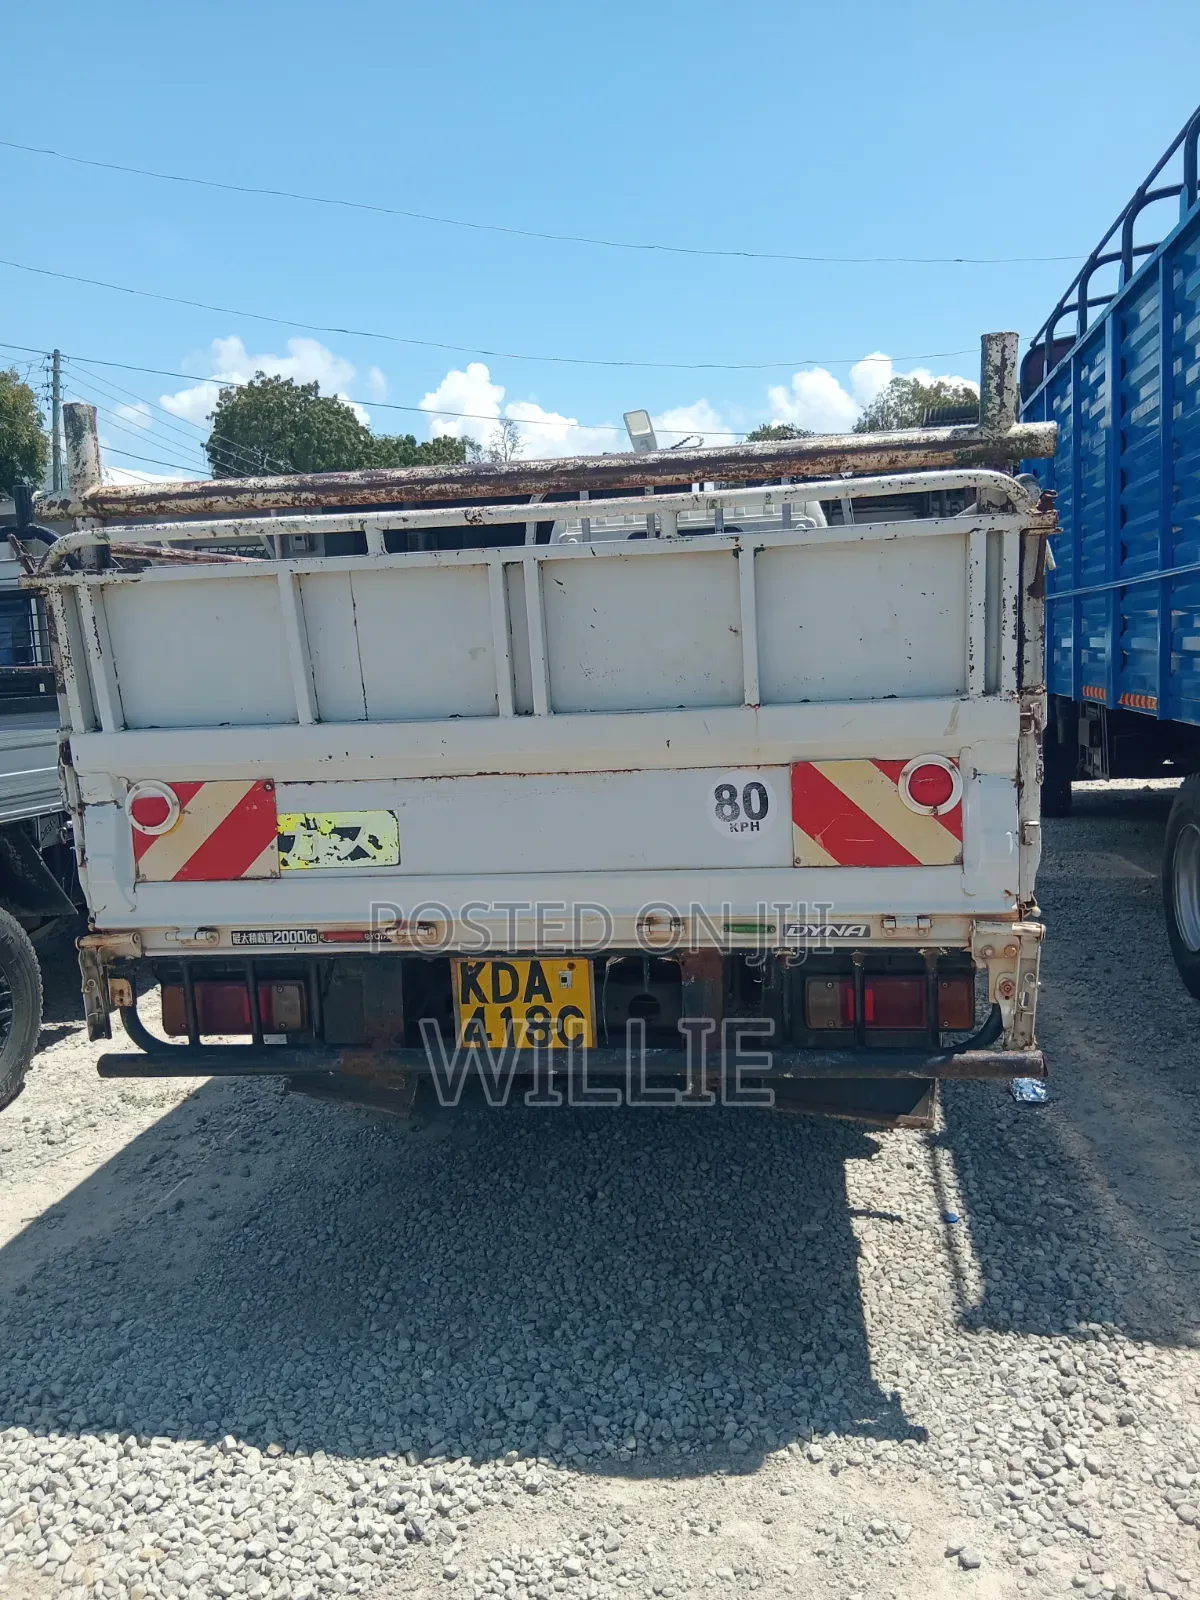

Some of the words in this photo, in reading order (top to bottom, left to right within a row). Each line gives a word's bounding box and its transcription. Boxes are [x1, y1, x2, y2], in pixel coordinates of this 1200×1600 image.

[714, 782, 769, 822] 80
[729, 821, 760, 832] KPH
[786, 924, 867, 937] DYNA
[460, 960, 553, 1004] KDA
[463, 1005, 585, 1048] 418C
